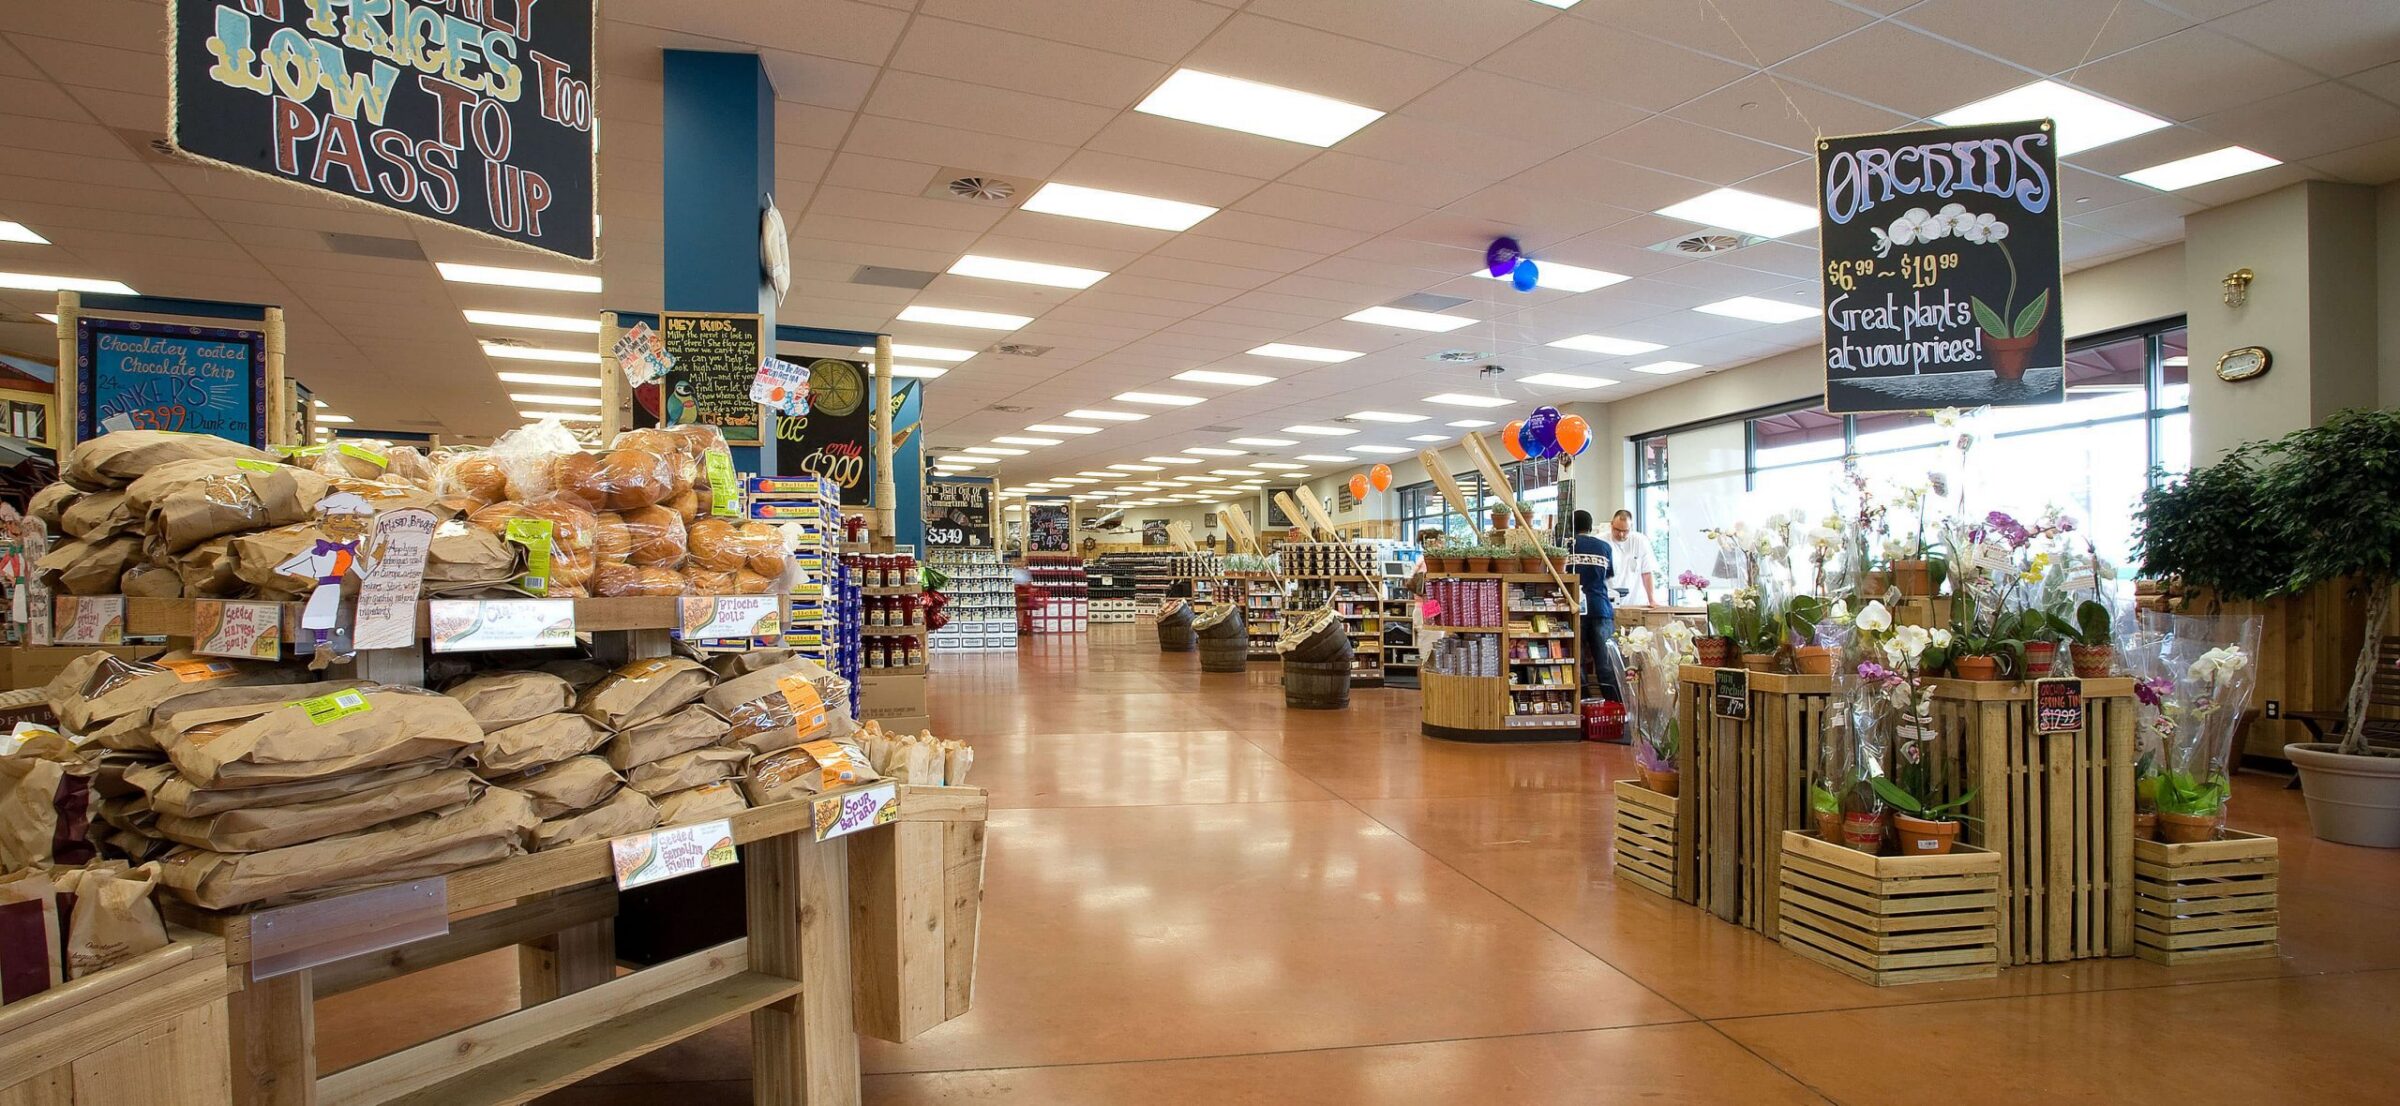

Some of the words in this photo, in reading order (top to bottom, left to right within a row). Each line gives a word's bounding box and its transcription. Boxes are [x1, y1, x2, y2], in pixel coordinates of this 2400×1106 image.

[207, 4, 399, 126] LOW
[419, 74, 512, 162] TO
[273, 95, 459, 215] PASS
[485, 158, 552, 237] UP
[1828, 292, 1901, 332] Great
[1904, 289, 1971, 341] plants
[668, 318, 696, 331] HEY
[667, 330, 685, 341] Milly
[687, 330, 698, 339] the
[700, 332, 719, 341] parrot
[730, 331, 743, 340] lost
[683, 339, 706, 347] store!
[707, 339, 721, 347] She
[722, 339, 738, 347] flew
[99, 335, 188, 363] Chocolatey
[197, 343, 246, 360] coated
[667, 345, 682, 353] and
[737, 346, 756, 355] find
[1828, 335, 1856, 372] at
[1856, 341, 1910, 369] wow
[1912, 326, 1983, 375] prices!
[708, 356, 722, 365] you
[724, 353, 749, 363] help?
[120, 357, 196, 376] Chocolate
[201, 362, 235, 382] Chip
[693, 362, 711, 373] high
[712, 363, 729, 371] and
[731, 363, 744, 371] low
[745, 363, 757, 372] for
[695, 380, 713, 392] find
[100, 376, 209, 417] DUNKERS
[731, 406, 757, 415] yummy
[825, 439, 862, 459] only
[940, 493, 957, 501] Park
[962, 494, 982, 502] With
[379, 517, 407, 534] Artisan
[719, 599, 758, 610] Brioche
[226, 606, 254, 625] Seeded
[224, 623, 256, 639] Harvest
[225, 636, 248, 652] Boule
[659, 828, 694, 852] Seeded
